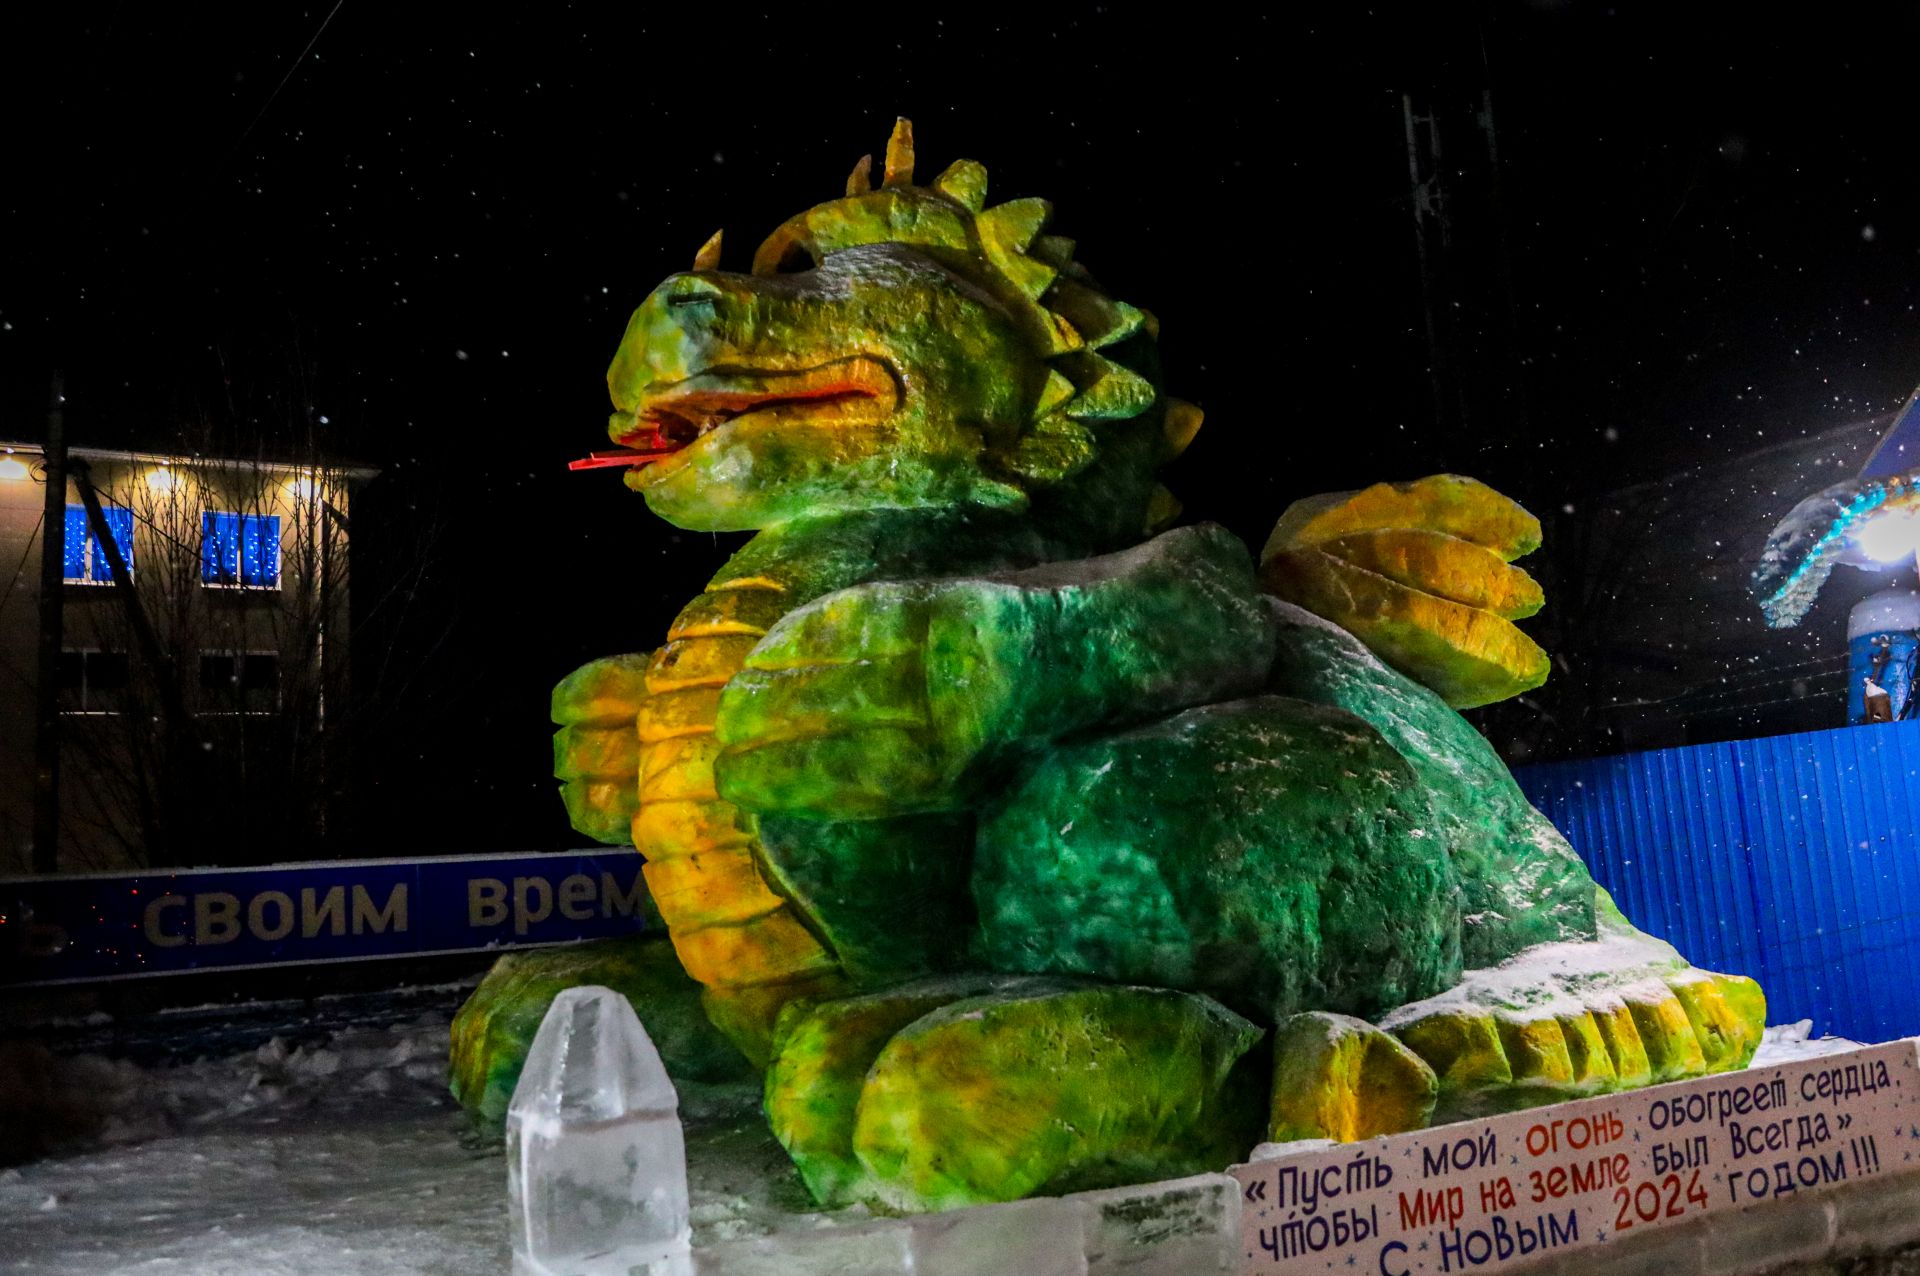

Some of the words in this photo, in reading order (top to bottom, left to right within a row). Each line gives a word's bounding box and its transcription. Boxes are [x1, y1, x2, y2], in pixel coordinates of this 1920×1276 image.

[1423, 1127, 1498, 1178] мой
[1526, 1111, 1624, 1157] огонь
[1529, 1152, 1631, 1204] земле
[1613, 1167, 1709, 1231] 2024
